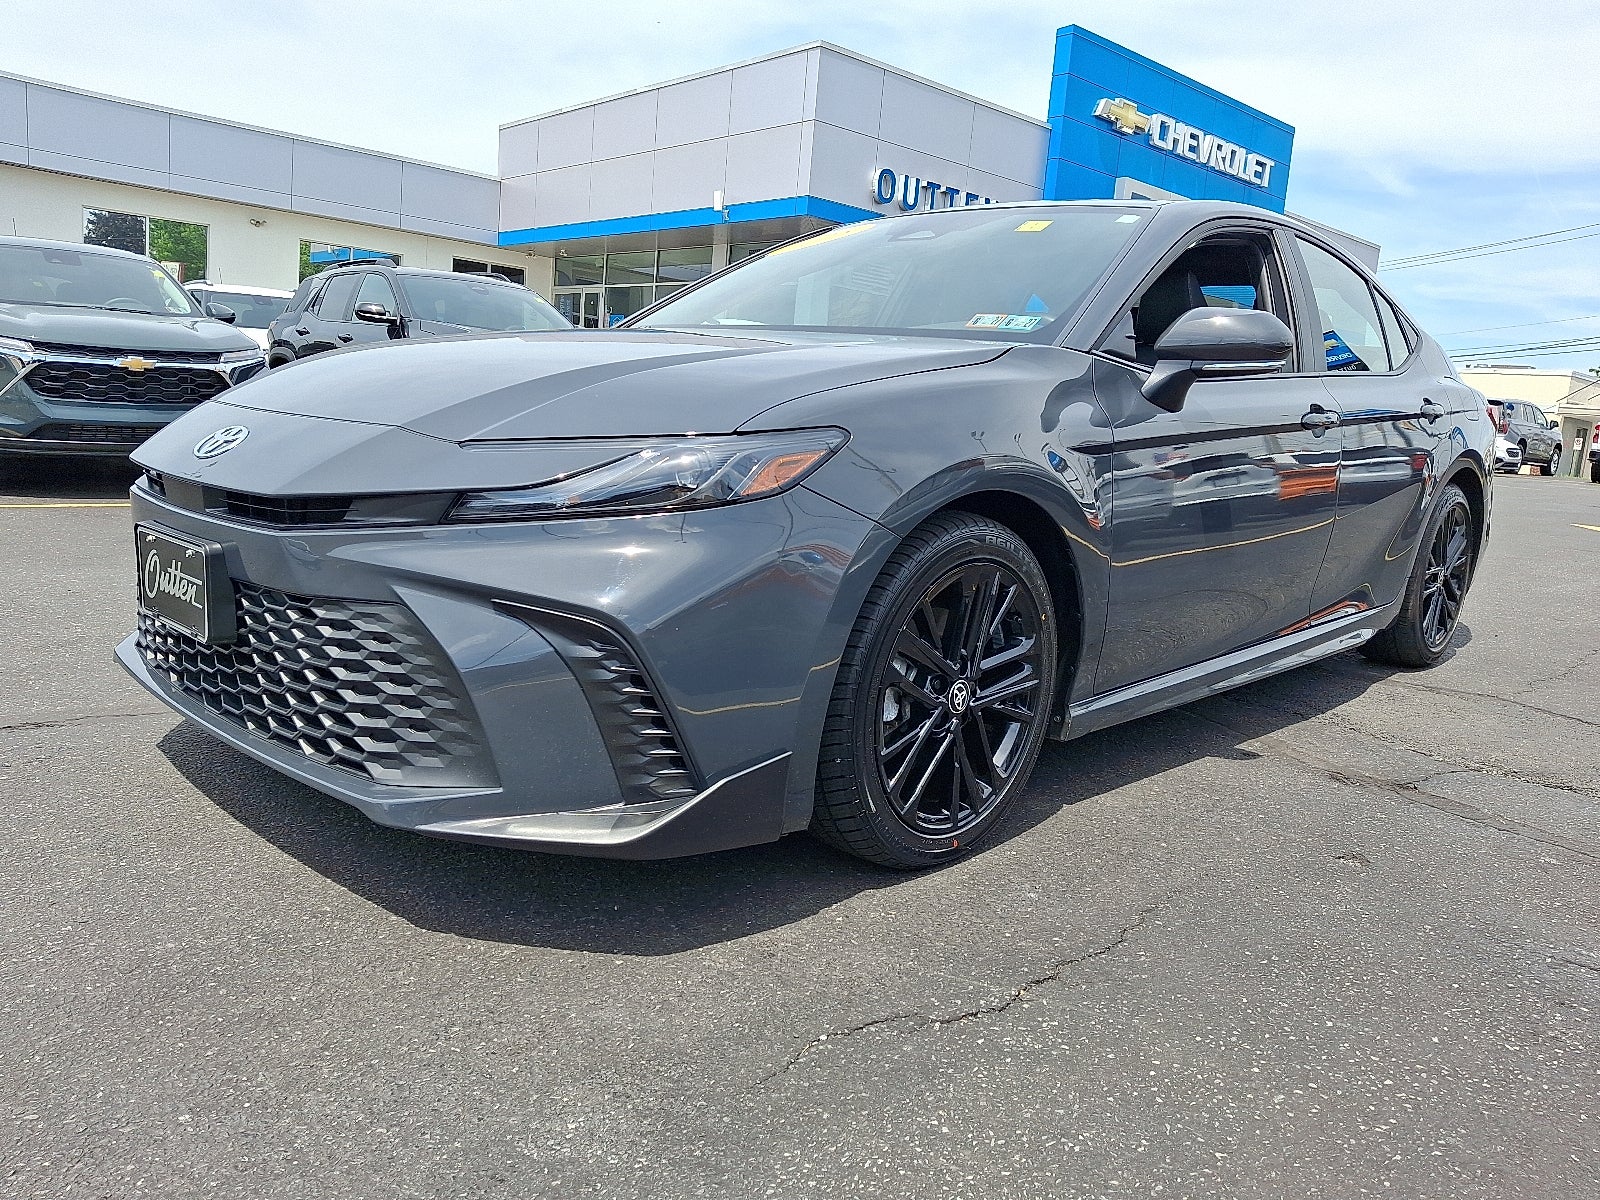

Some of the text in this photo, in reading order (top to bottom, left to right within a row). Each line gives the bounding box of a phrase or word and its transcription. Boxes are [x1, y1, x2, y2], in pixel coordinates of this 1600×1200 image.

[1149, 113, 1275, 188] CHEVROLET
[873, 168, 999, 211] OUTT
[145, 549, 203, 609] Outten
